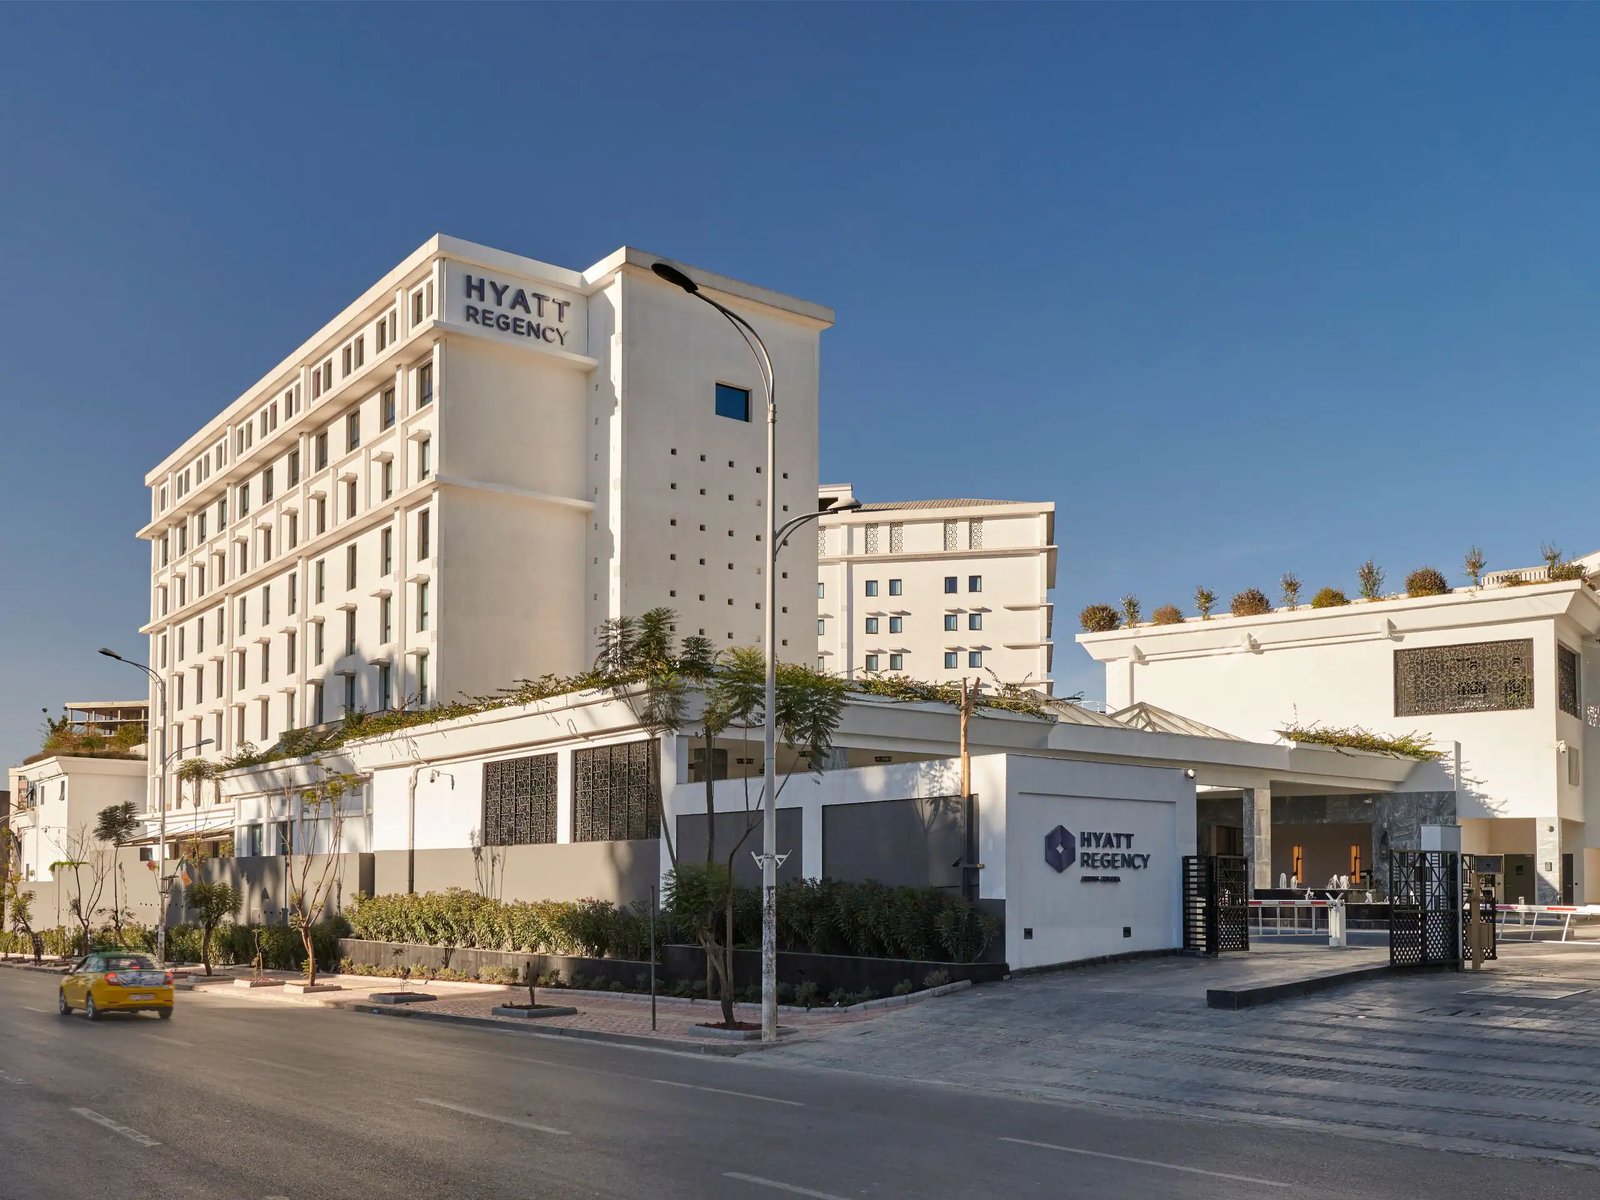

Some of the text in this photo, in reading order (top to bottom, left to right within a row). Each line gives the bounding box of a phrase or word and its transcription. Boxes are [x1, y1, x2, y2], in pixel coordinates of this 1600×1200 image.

[466, 274, 571, 323] HYATT
[465, 305, 568, 346] REGENCY
[1080, 831, 1134, 849] HYATT
[1080, 852, 1151, 869] REGENCY
